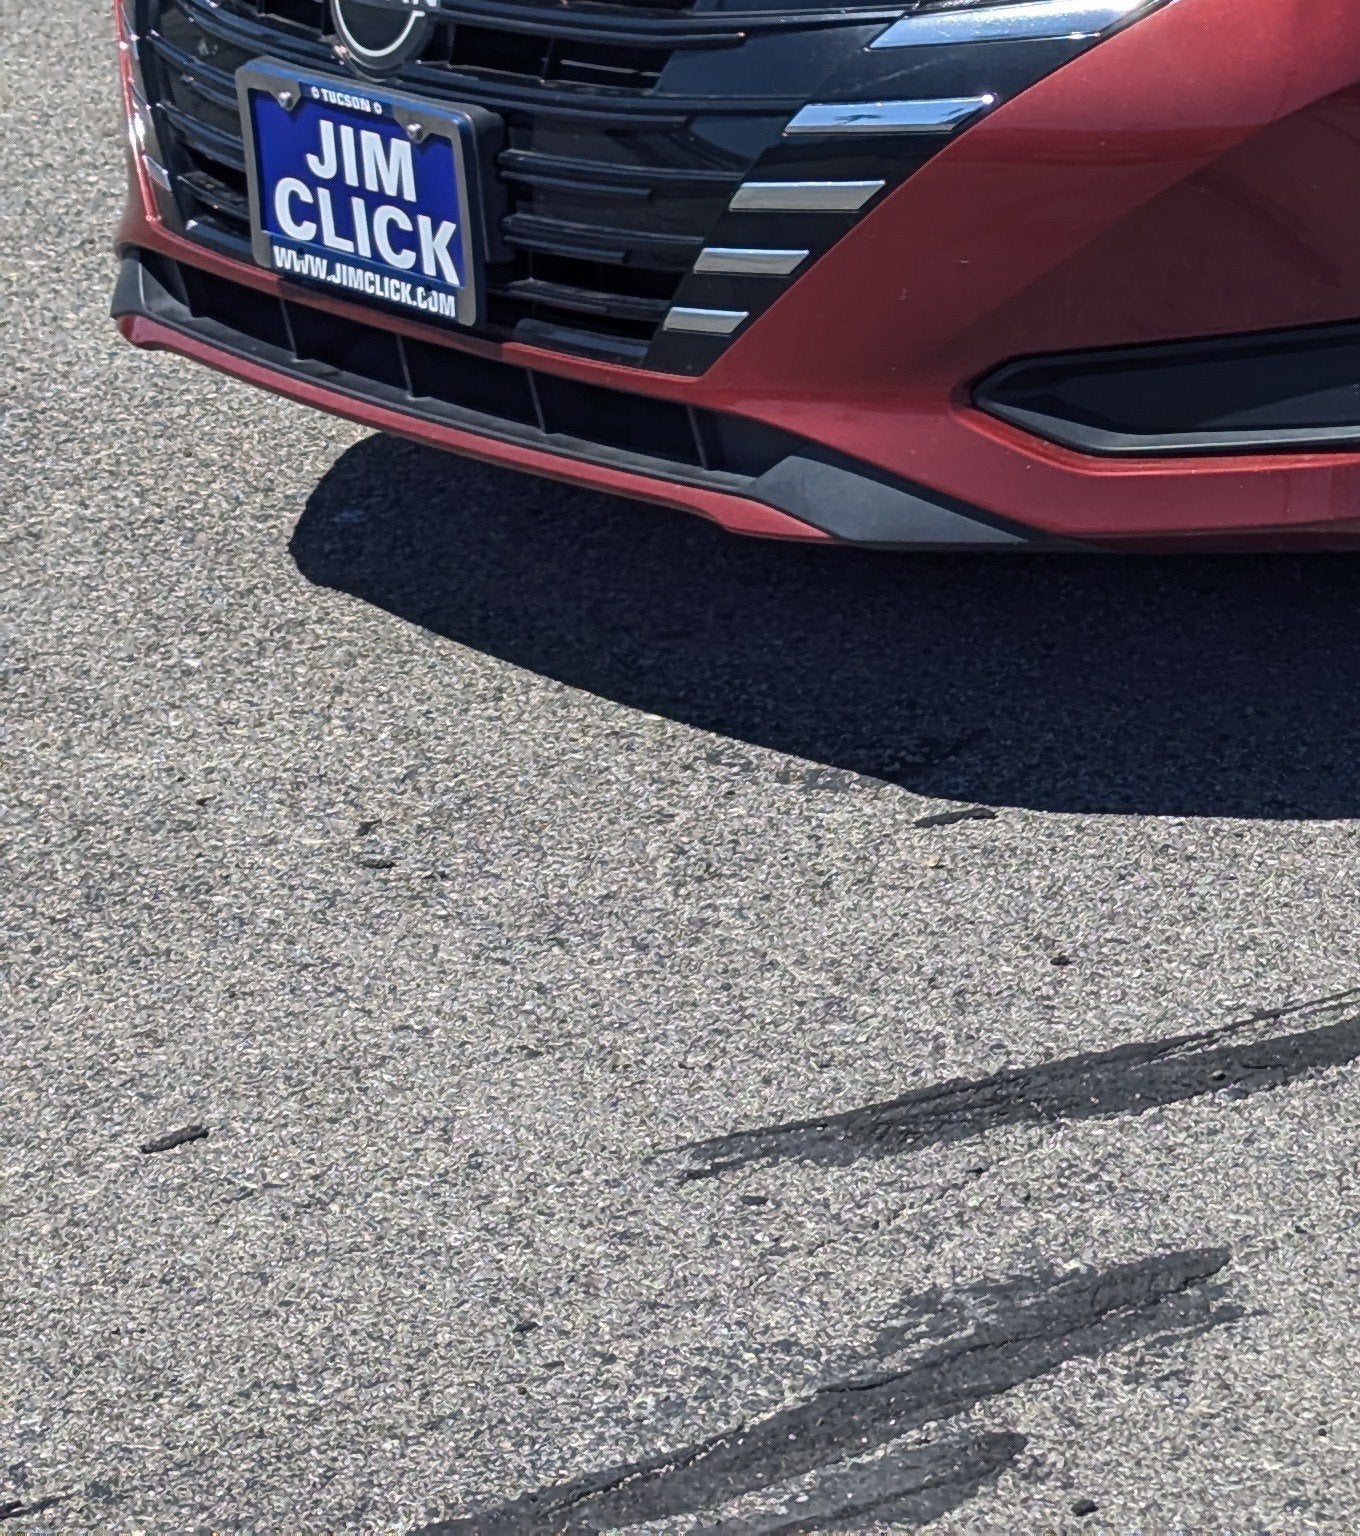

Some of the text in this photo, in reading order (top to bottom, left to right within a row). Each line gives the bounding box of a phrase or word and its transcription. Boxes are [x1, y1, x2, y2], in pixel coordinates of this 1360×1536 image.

[320, 87, 371, 114] TUCSON
[305, 119, 417, 203] JIM
[274, 177, 460, 286] CLICK
[273, 244, 456, 319] WWW.JIMCLICK.COM
